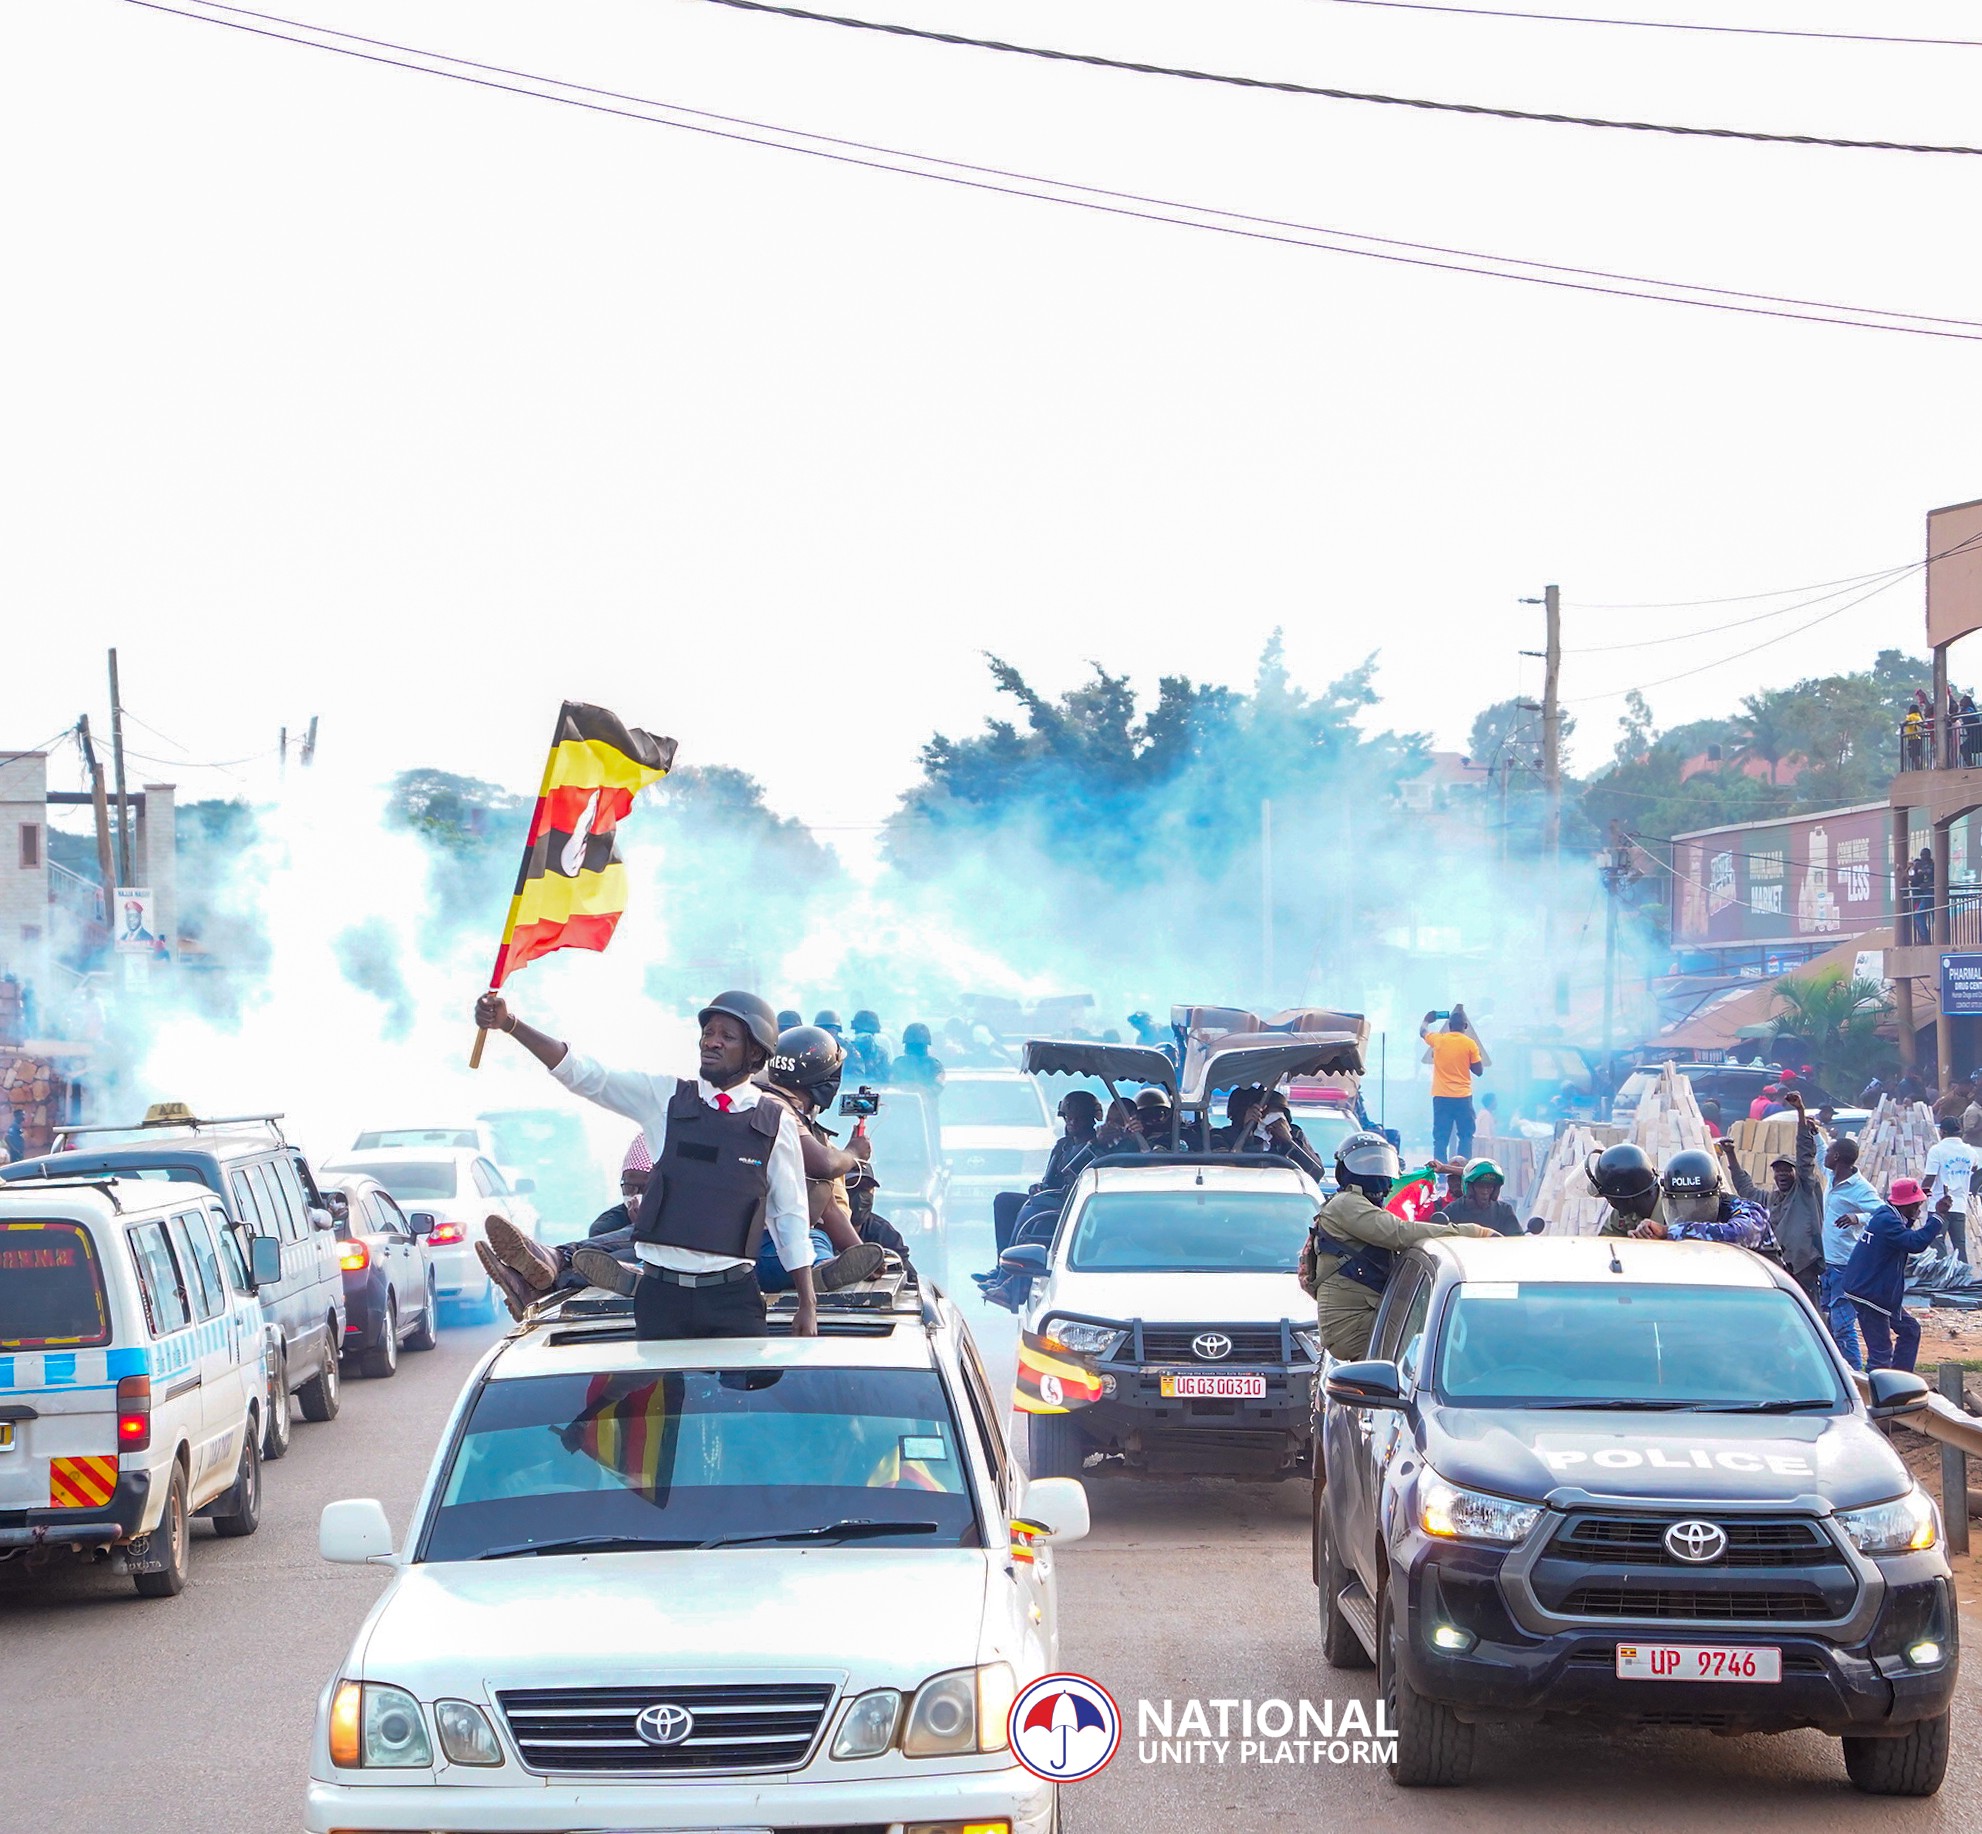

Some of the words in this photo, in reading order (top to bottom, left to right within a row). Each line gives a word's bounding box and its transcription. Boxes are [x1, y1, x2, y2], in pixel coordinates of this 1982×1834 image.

[1848, 864, 1870, 902] LESS
[1751, 884, 1783, 914] MARKET
[769, 1055, 796, 1072] RESS
[1672, 1177, 1701, 1186] POLICE
[1217, 1379, 1261, 1395] 00310
[1548, 1449, 1814, 1476] POLICE
[1651, 1650, 1681, 1675] UP
[1698, 1652, 1756, 1677] 9746
